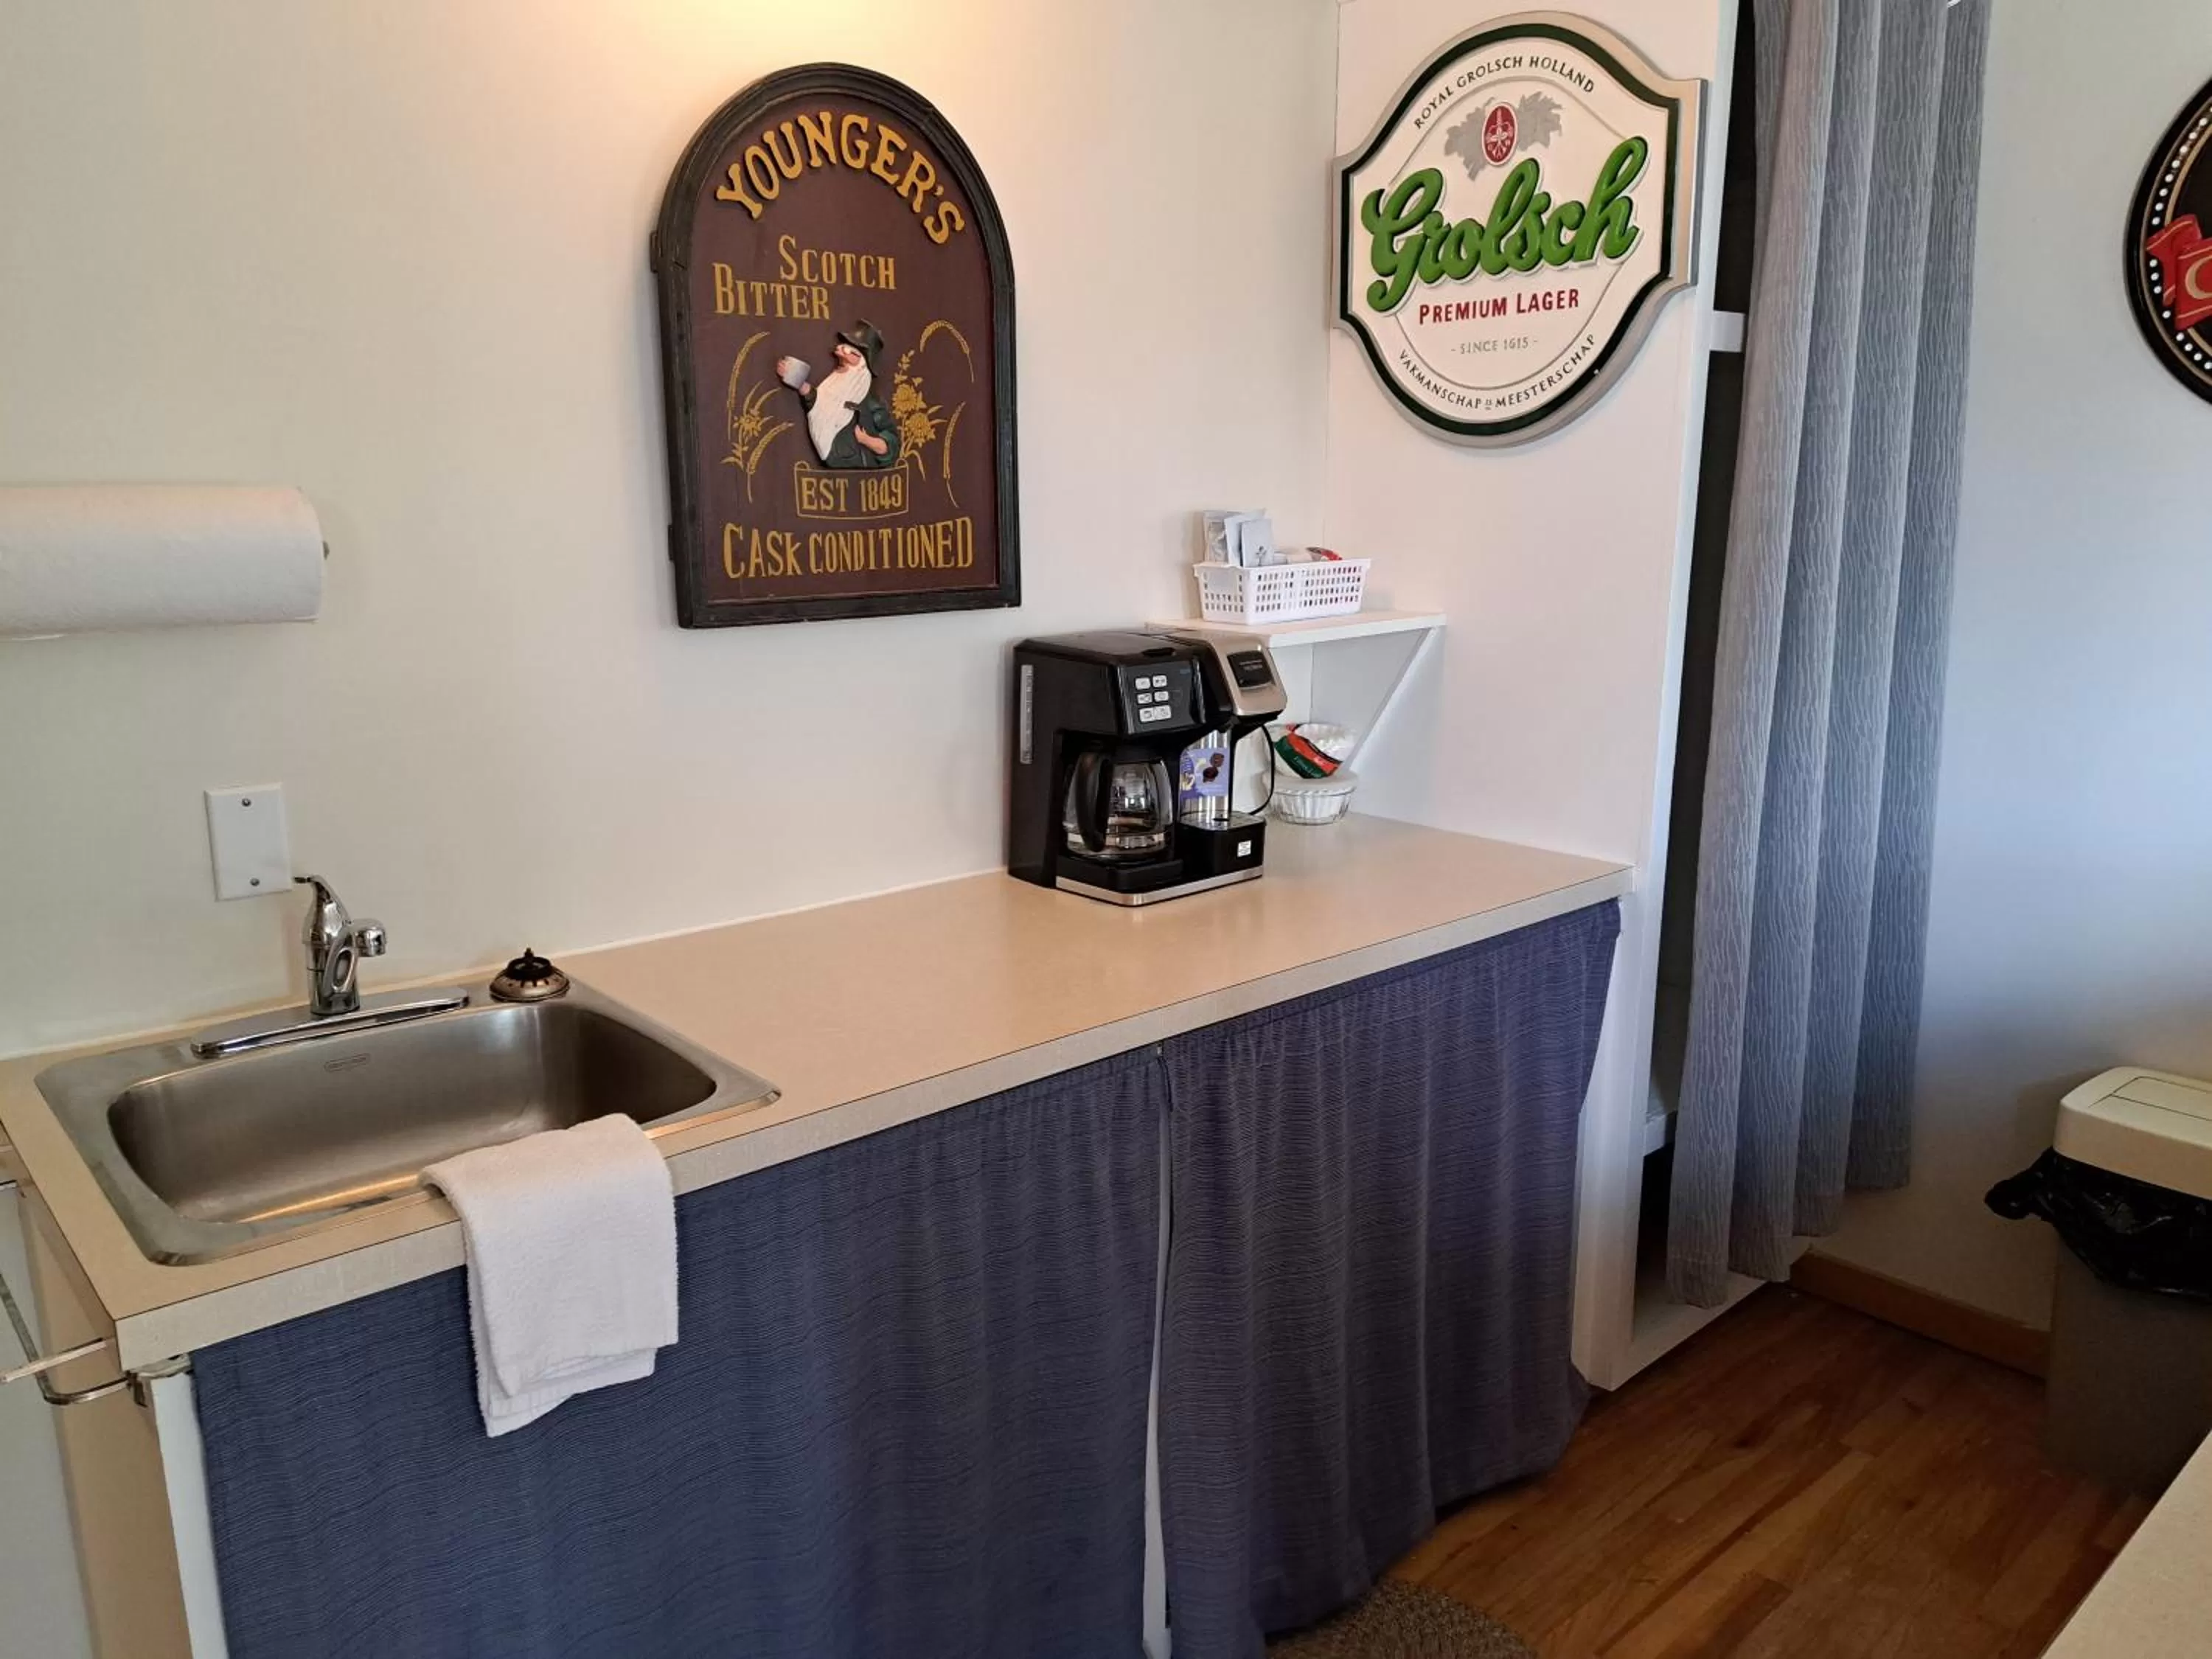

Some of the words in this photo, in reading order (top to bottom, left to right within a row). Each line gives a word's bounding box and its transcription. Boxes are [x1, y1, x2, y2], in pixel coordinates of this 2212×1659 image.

[1413, 86, 1454, 129] ROYAL
[1457, 56, 1523, 88] GROLSCH
[1528, 56, 1595, 93] HOLLAND
[715, 111, 966, 244] YOUNGER'S
[1360, 135, 1648, 313] Grolsch
[712, 262, 830, 320] BITTER
[778, 234, 897, 290] SCOTCH
[1419, 297, 1508, 324] PREMIUM
[1516, 288, 1579, 314] LAGER
[1399, 349, 1481, 409] VAKMANSCHAP
[1495, 334, 1596, 407] MEESTERSCHAP
[1460, 340, 1498, 355] SINCE
[1503, 336, 1528, 350] 1615
[801, 476, 849, 512] EST
[860, 475, 903, 512] 1849
[808, 516, 973, 575] CONDITIONED
